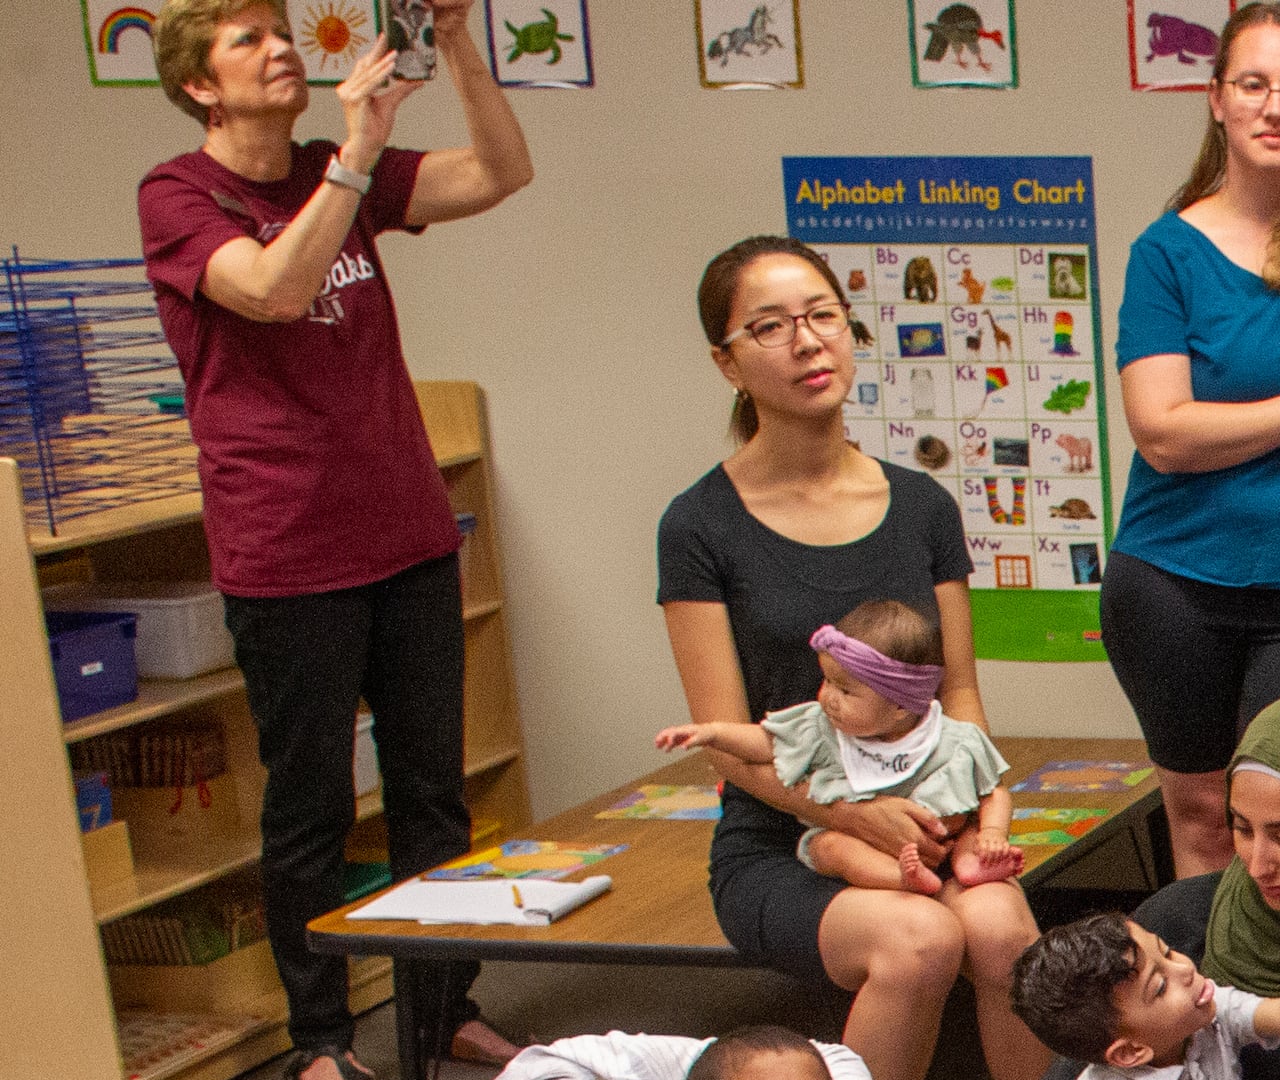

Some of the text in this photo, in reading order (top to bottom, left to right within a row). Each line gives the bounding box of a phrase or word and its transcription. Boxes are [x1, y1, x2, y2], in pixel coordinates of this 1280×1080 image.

[796, 179, 1085, 210] Alphabet Linking Chart
[876, 247, 898, 264] Bb
[947, 247, 971, 264] Cc
[1020, 248, 1044, 265] Dd
[321, 251, 375, 295] aks
[881, 305, 896, 322] Ff
[951, 306, 978, 328] Gg
[1024, 307, 1047, 323] Hh
[884, 364, 896, 385] Jj
[956, 365, 978, 381] Kk
[889, 422, 914, 438] Nn
[960, 422, 987, 439] Oo
[1031, 423, 1052, 445] Pp
[964, 480, 982, 496] Ss
[1035, 480, 1050, 496] Tt
[967, 537, 1002, 551] Ww
[1038, 537, 1060, 552] Xx
